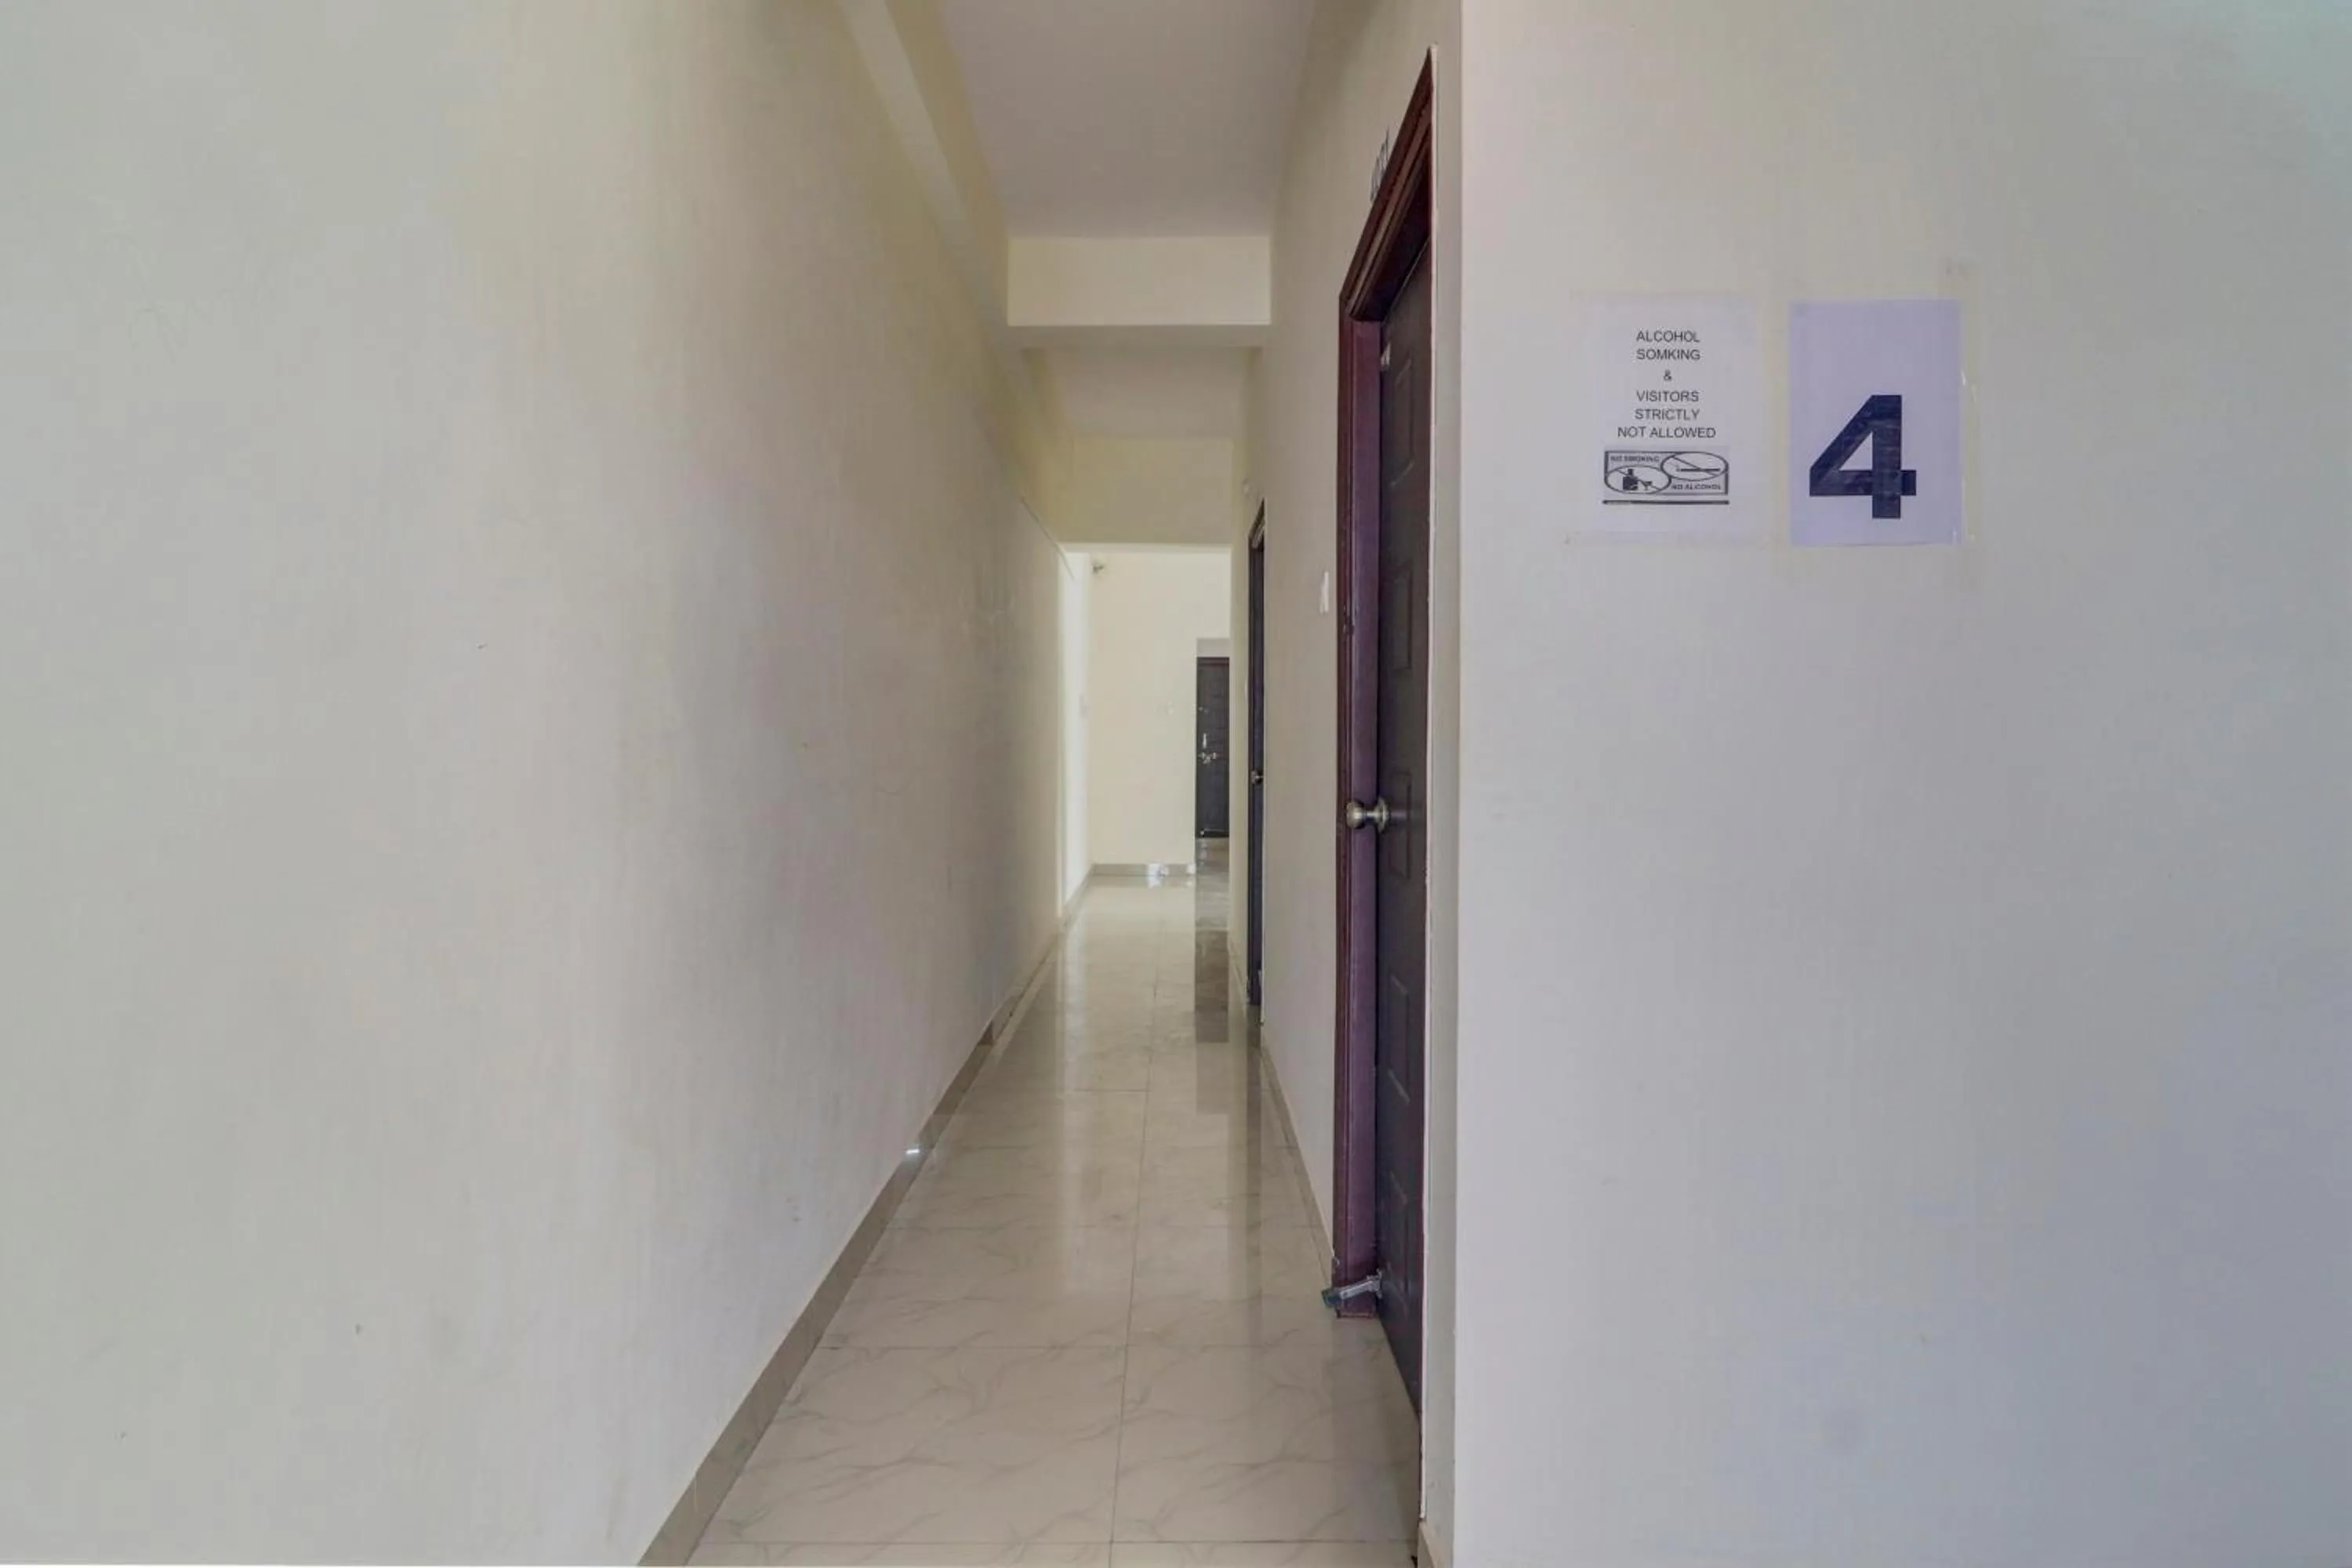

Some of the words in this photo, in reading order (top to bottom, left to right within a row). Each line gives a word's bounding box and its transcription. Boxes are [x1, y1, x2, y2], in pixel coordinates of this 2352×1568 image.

[1636, 330, 1700, 343] ALCOHOL
[1636, 348, 1700, 361] SOMKING
[1663, 369, 1672, 382] &
[1636, 390, 1700, 403] VISITORS
[1635, 408, 1700, 421] STRICTLY
[1617, 426, 1647, 438] NOT
[1649, 426, 1716, 439] ALLOWED
[1809, 394, 1917, 519] 4
